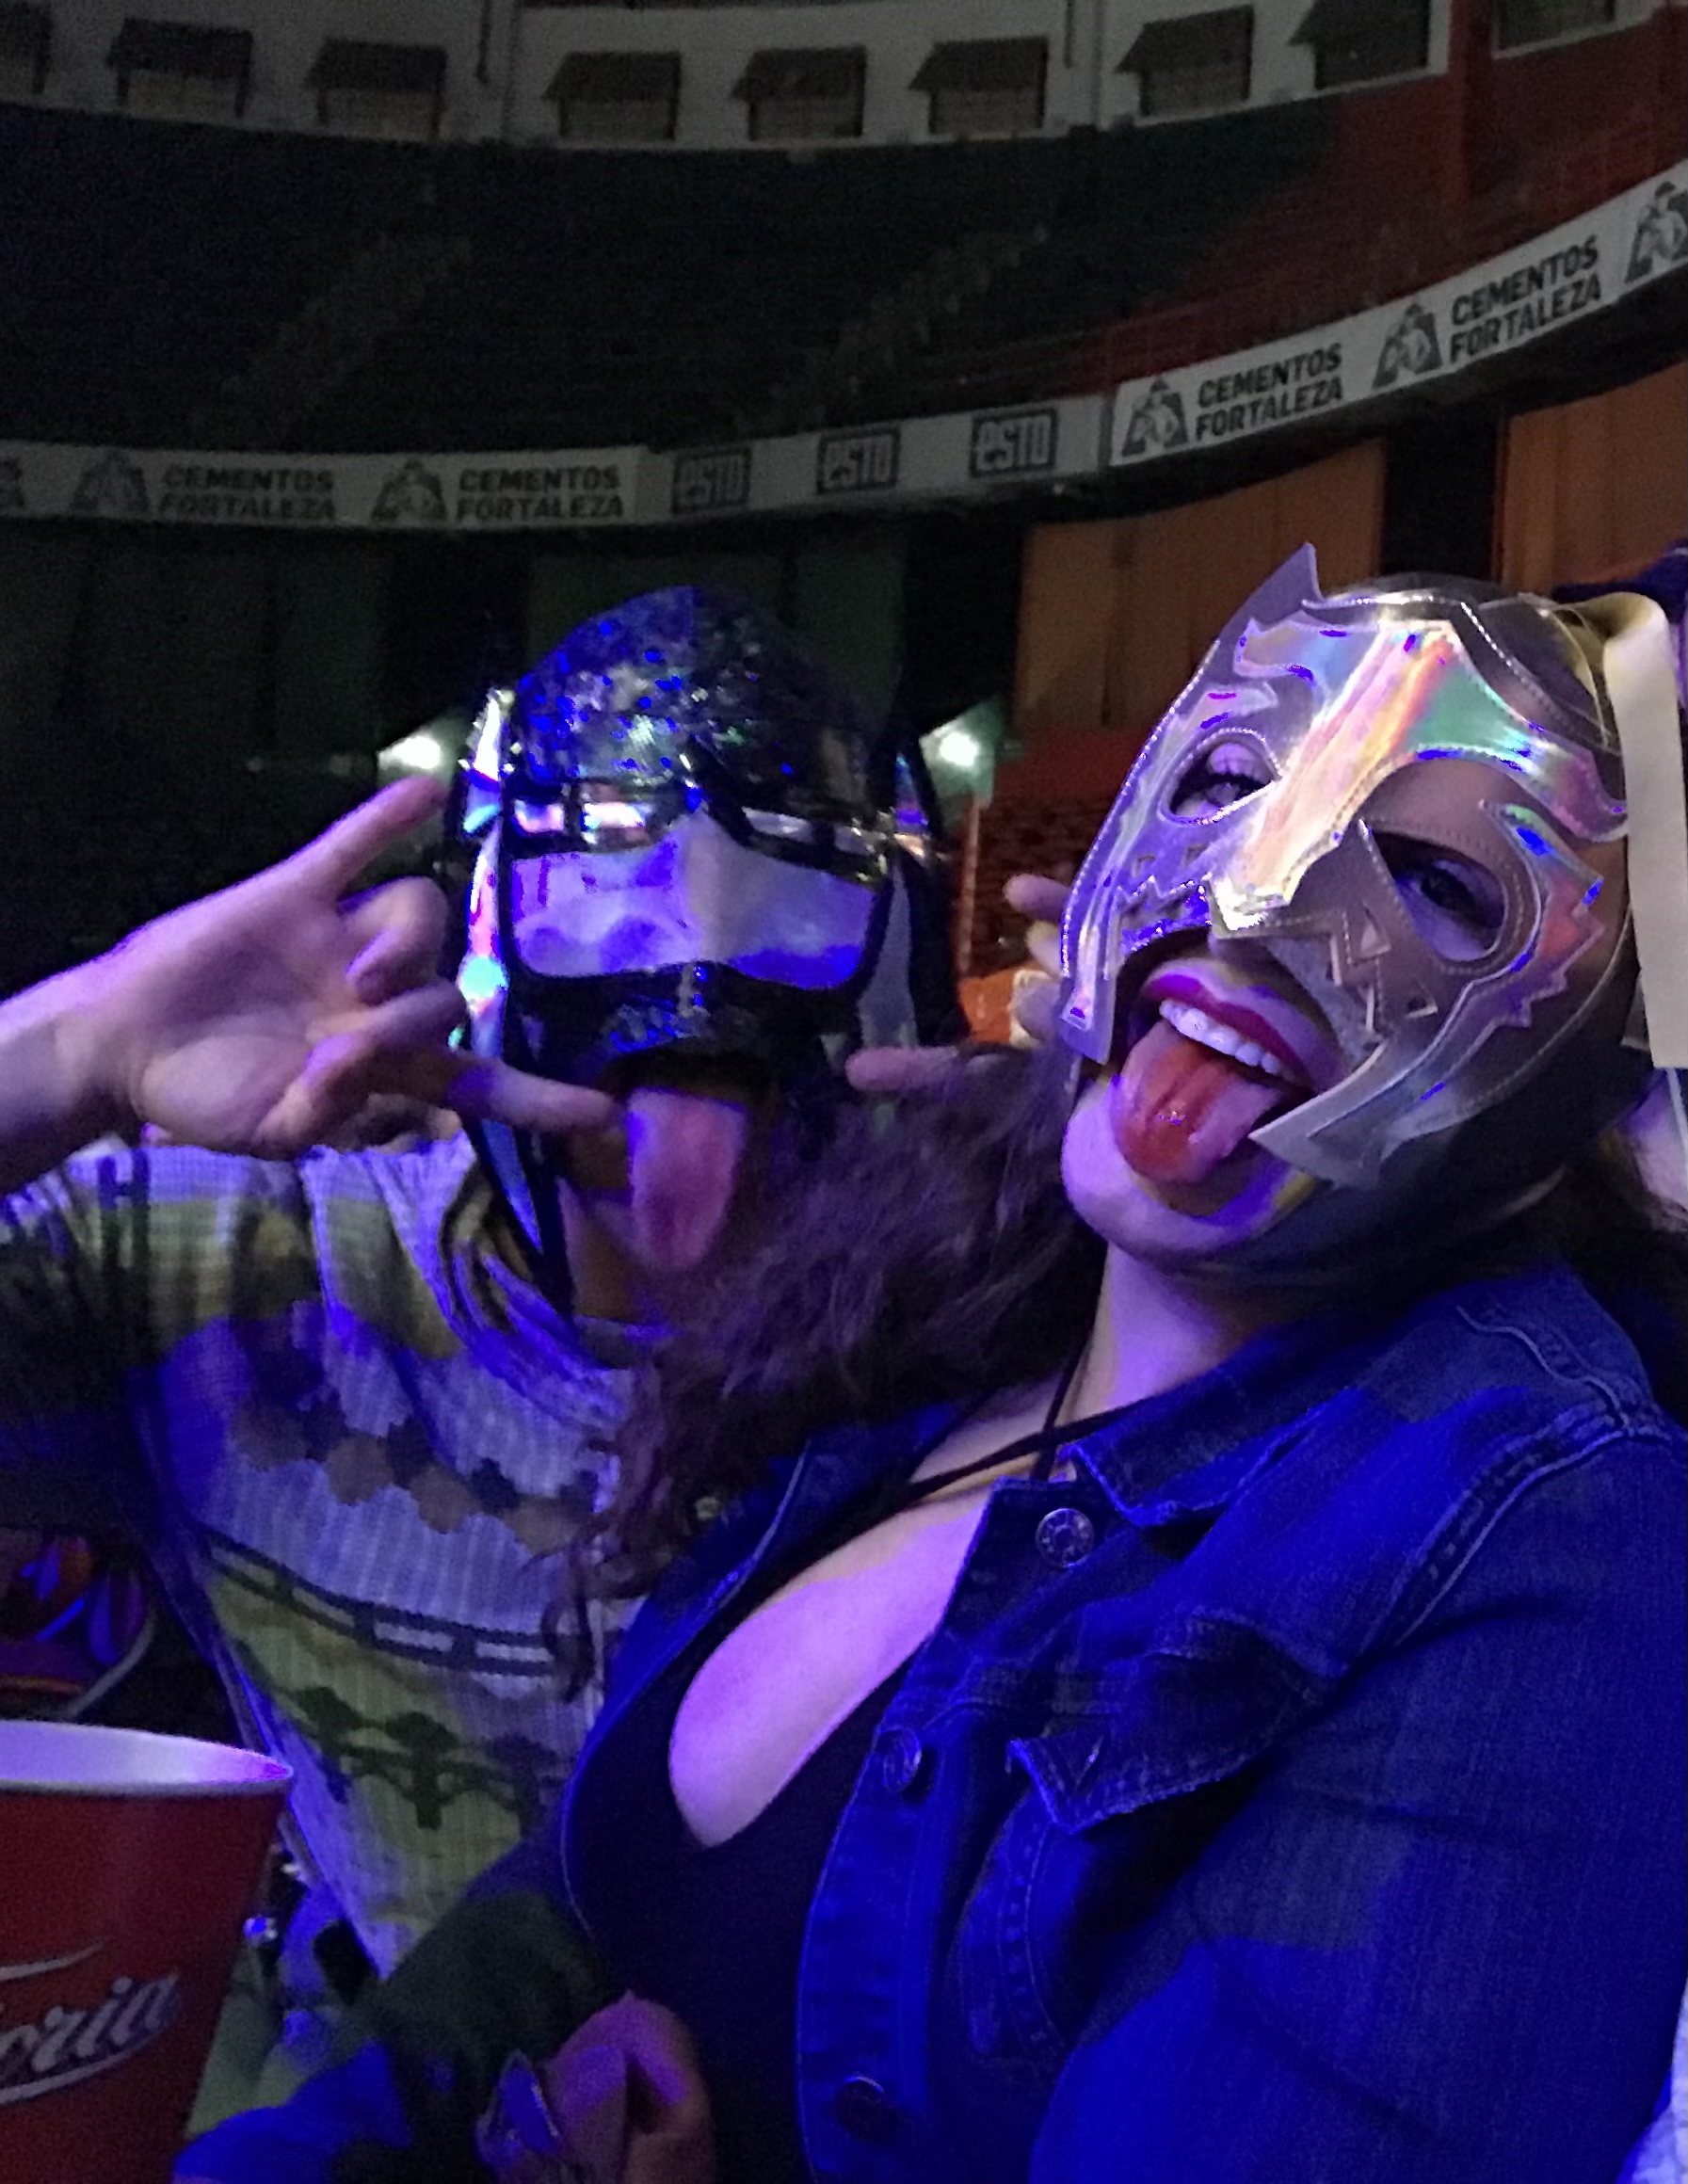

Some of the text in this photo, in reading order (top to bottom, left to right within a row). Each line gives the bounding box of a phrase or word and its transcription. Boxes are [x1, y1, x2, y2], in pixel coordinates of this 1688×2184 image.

[1452, 235, 1599, 326] CEMENTOS
[1450, 274, 1601, 362] FORTALEZA
[1198, 344, 1343, 410] CEMENTOS
[1196, 376, 1344, 441] FORTALEZA
[164, 465, 335, 492] CEMENTOS
[458, 466, 619, 493] CEMENTOS
[159, 494, 337, 522] FORTALEZA
[457, 495, 623, 522] FORTALEZA
